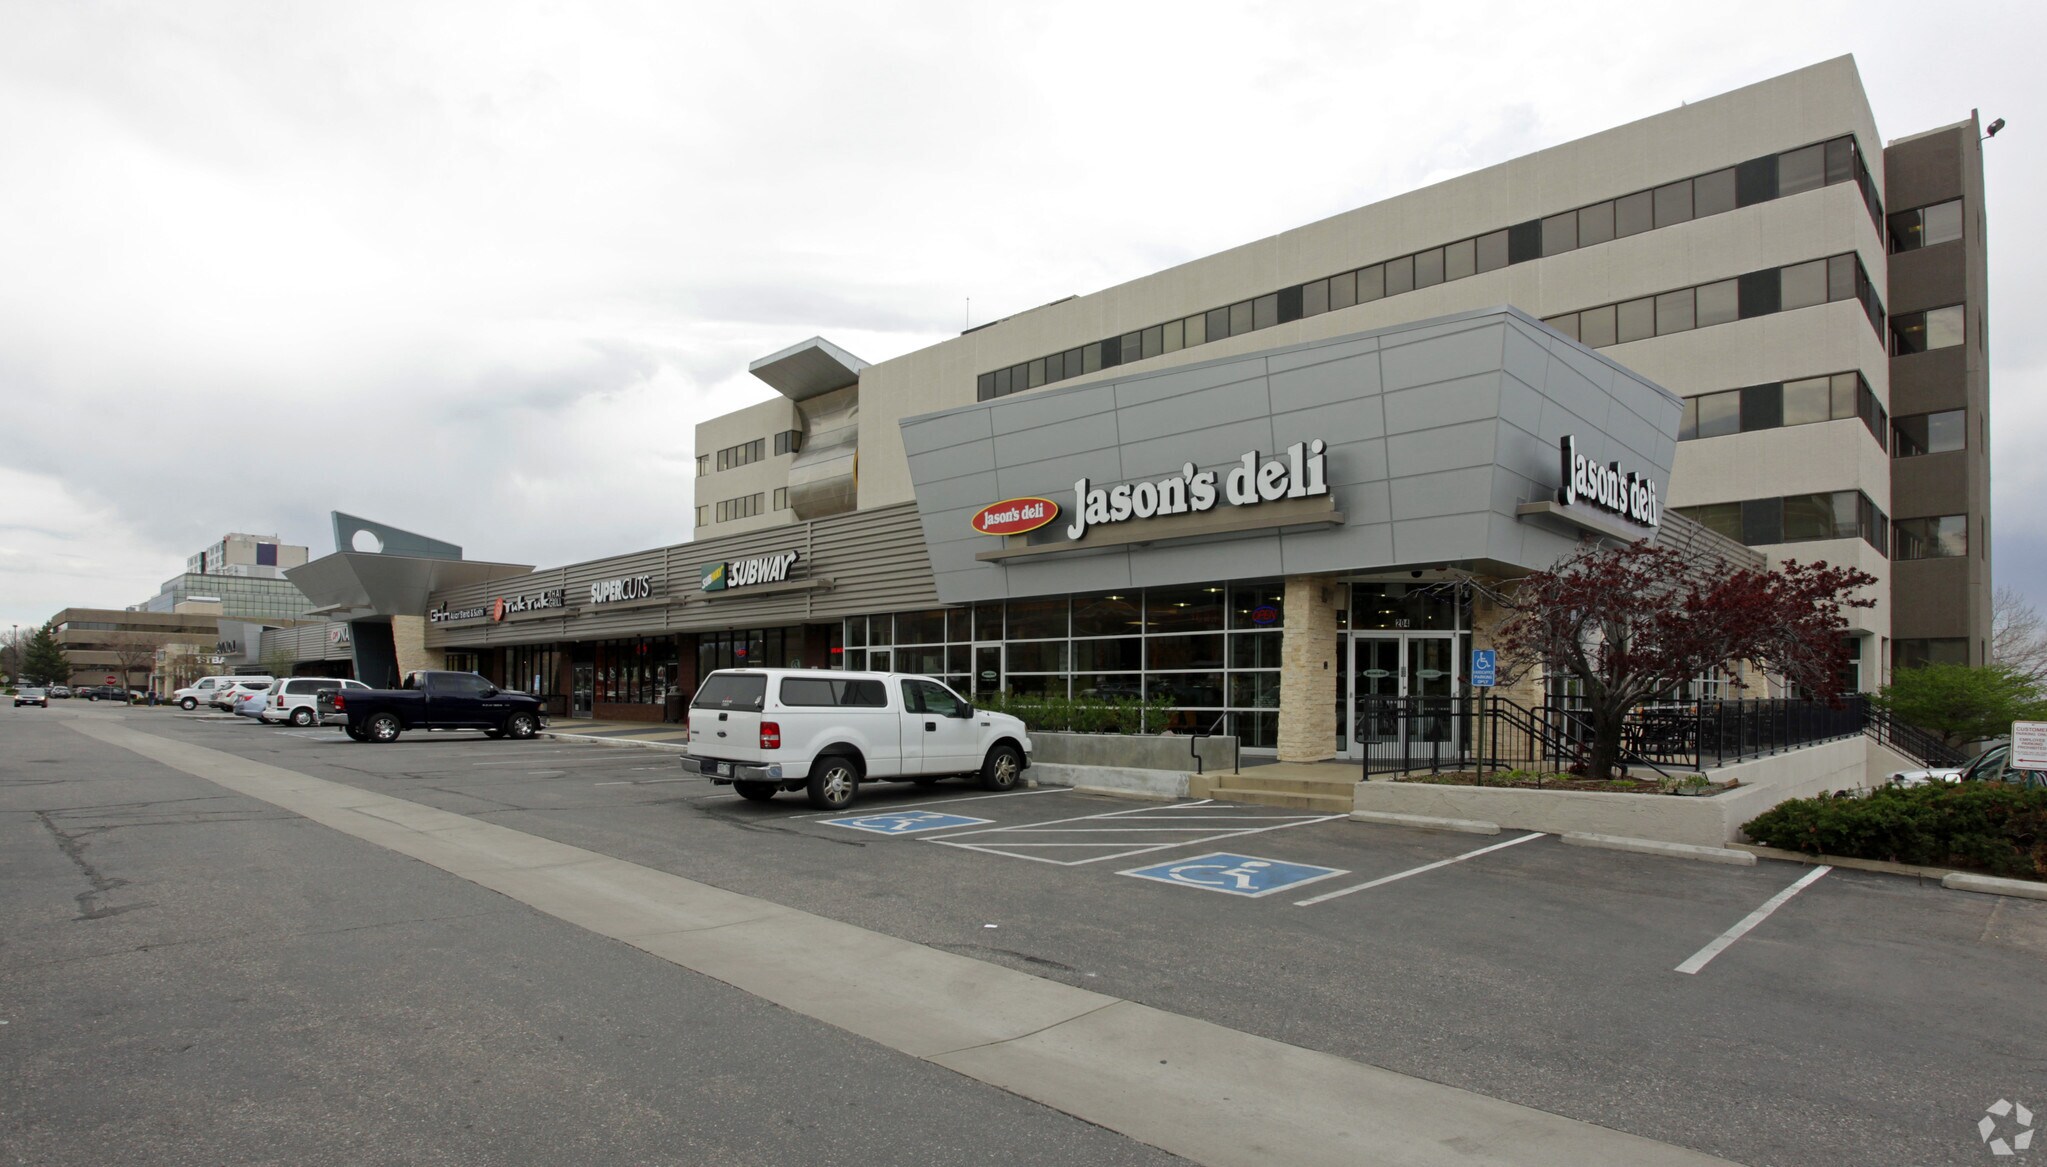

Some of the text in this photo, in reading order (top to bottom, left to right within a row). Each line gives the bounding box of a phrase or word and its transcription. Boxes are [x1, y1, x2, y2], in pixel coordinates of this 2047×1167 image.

[1067, 438, 1329, 540] Jason's deli
[1564, 434, 1658, 527] Jason's deli
[982, 502, 1044, 530] Jason's deli
[727, 550, 798, 588] SUBWAY
[590, 574, 649, 604] SUPERCUTS
[1252, 609, 1276, 621] OPEN
[1396, 618, 1410, 628] 204
